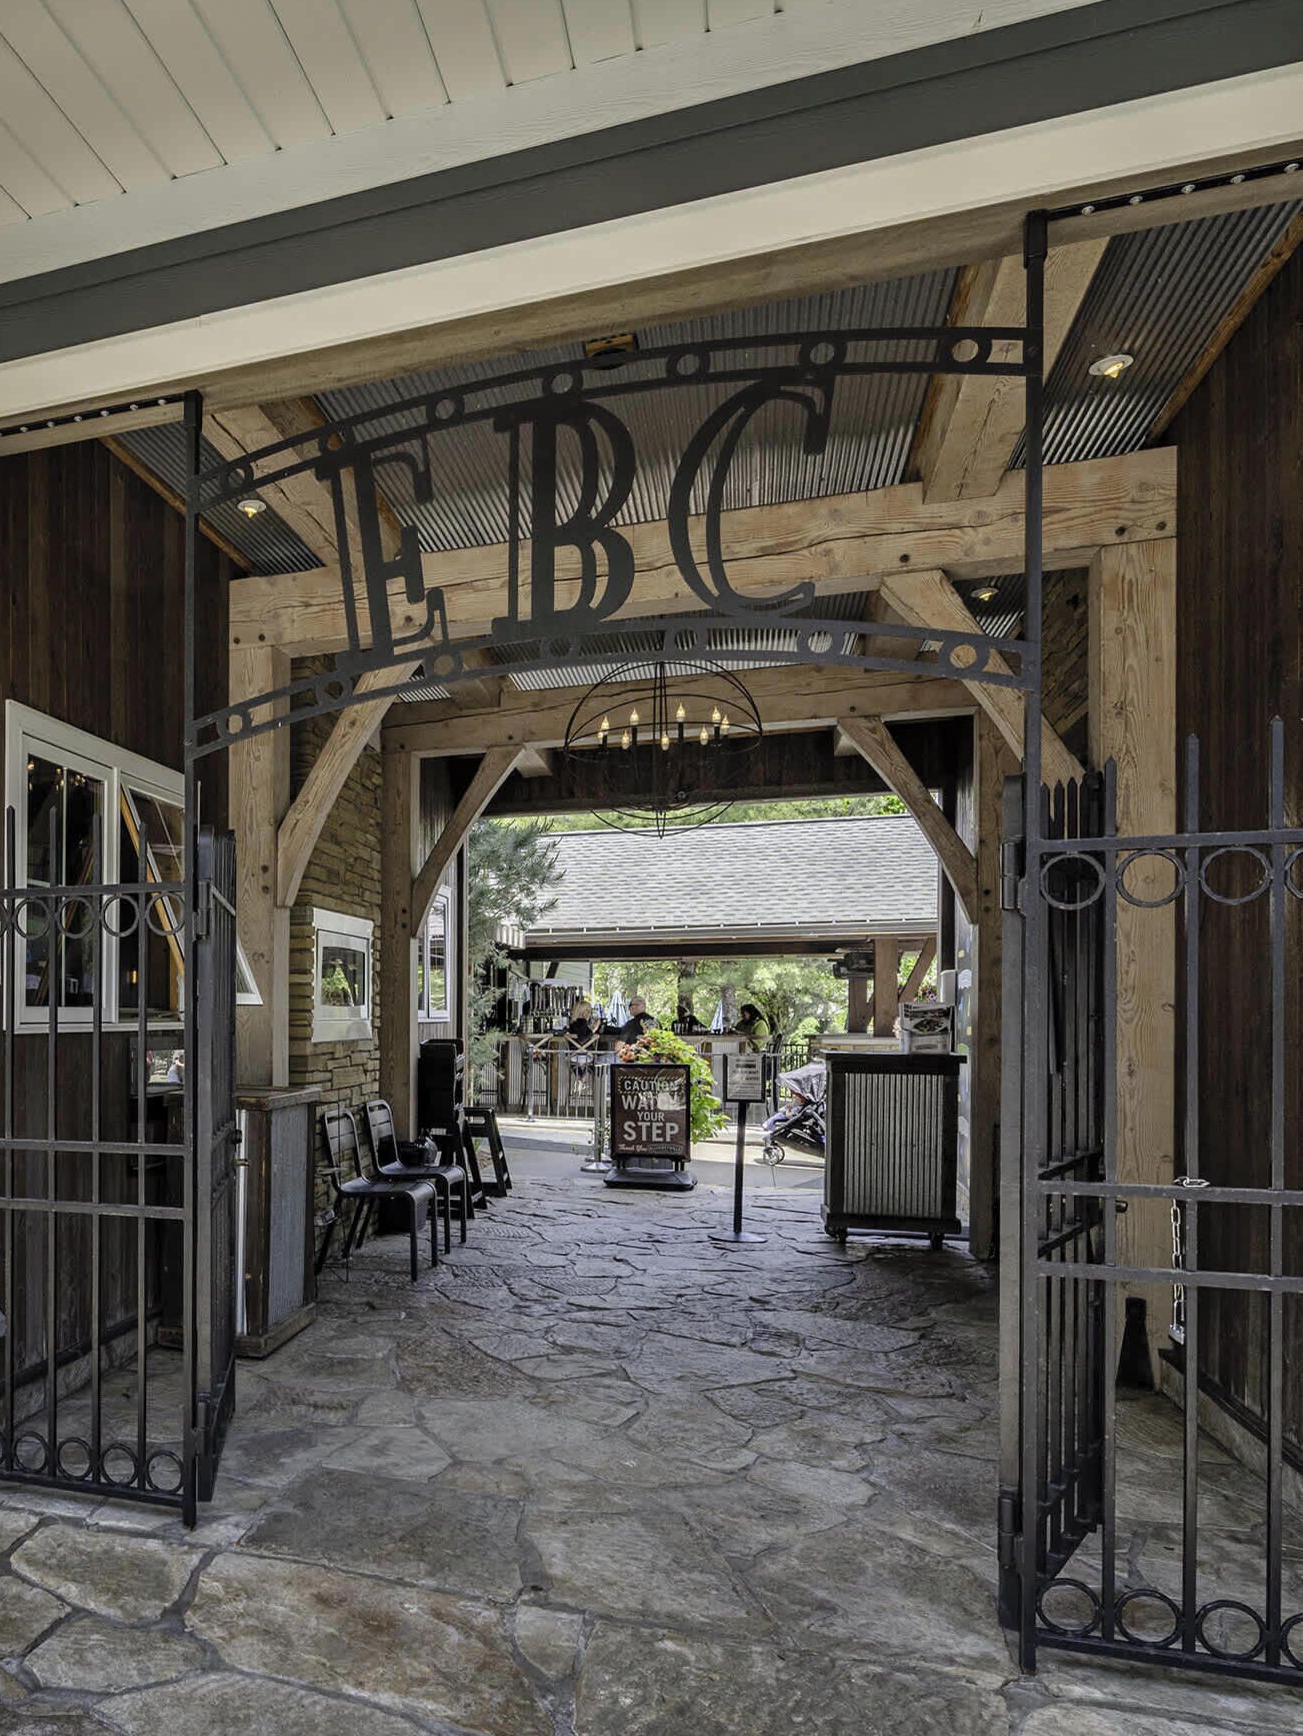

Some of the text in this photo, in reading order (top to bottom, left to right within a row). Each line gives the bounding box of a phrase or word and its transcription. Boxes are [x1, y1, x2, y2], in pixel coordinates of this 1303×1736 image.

[314, 373, 834, 668] EBC
[621, 1094, 679, 1110] WAT
[637, 1112, 665, 1121] YOUR
[623, 1121, 679, 1142] STEP
